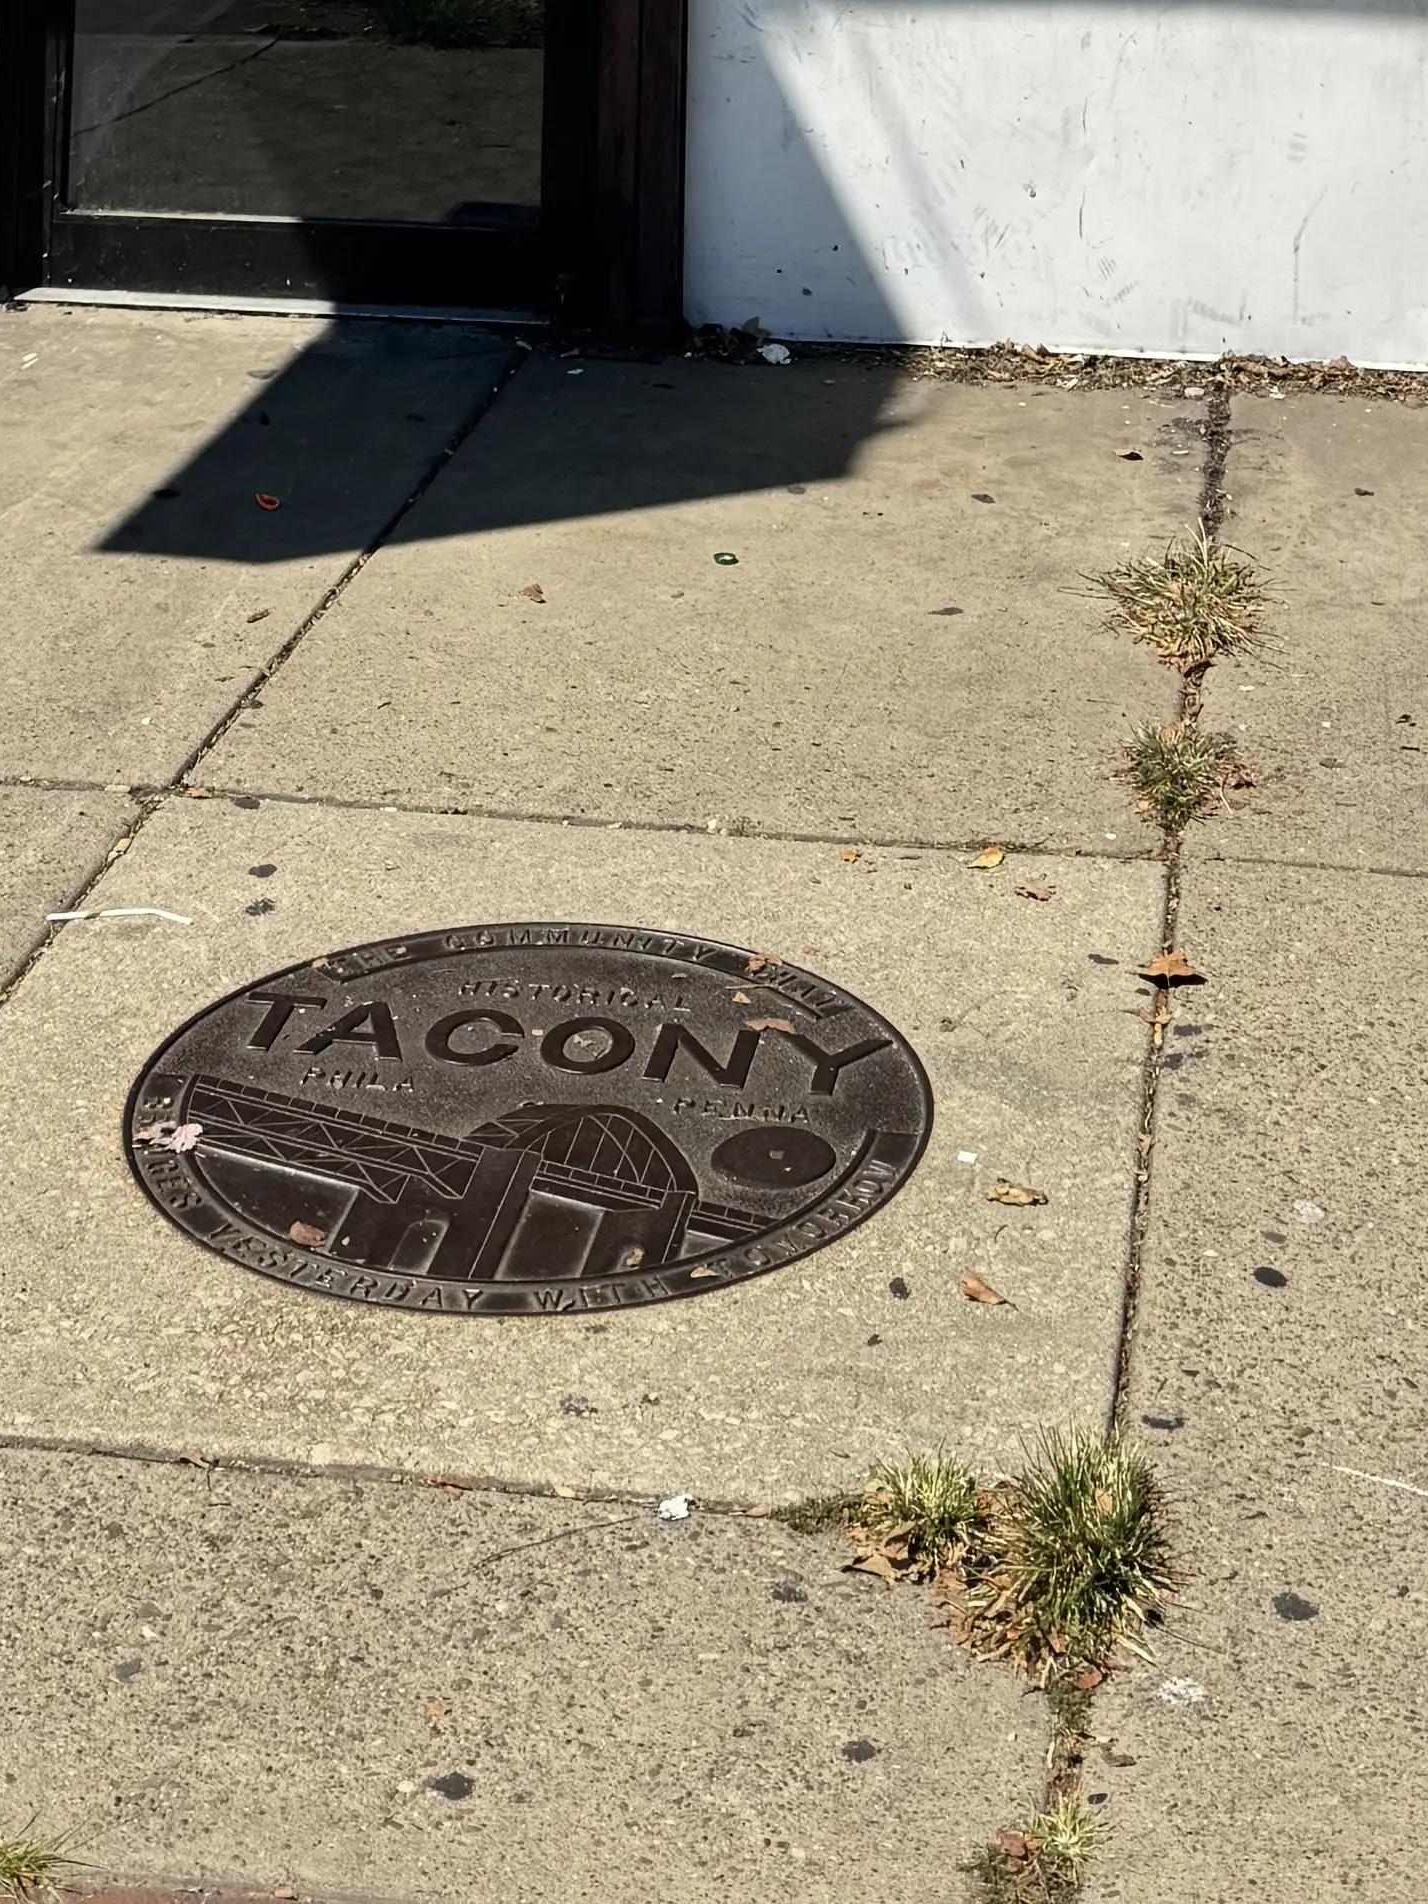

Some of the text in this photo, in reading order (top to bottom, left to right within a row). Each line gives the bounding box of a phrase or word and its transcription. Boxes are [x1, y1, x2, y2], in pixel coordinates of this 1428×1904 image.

[444, 928, 718, 961] COMMUNITY
[458, 978, 692, 1013] HISTORICAL
[245, 991, 894, 1096] TACONY
[300, 1066, 415, 1093] PHILA
[673, 1096, 813, 1124] PENNA
[139, 1096, 899, 1311] BRGES YESTERDAY WITH TOMORROW
